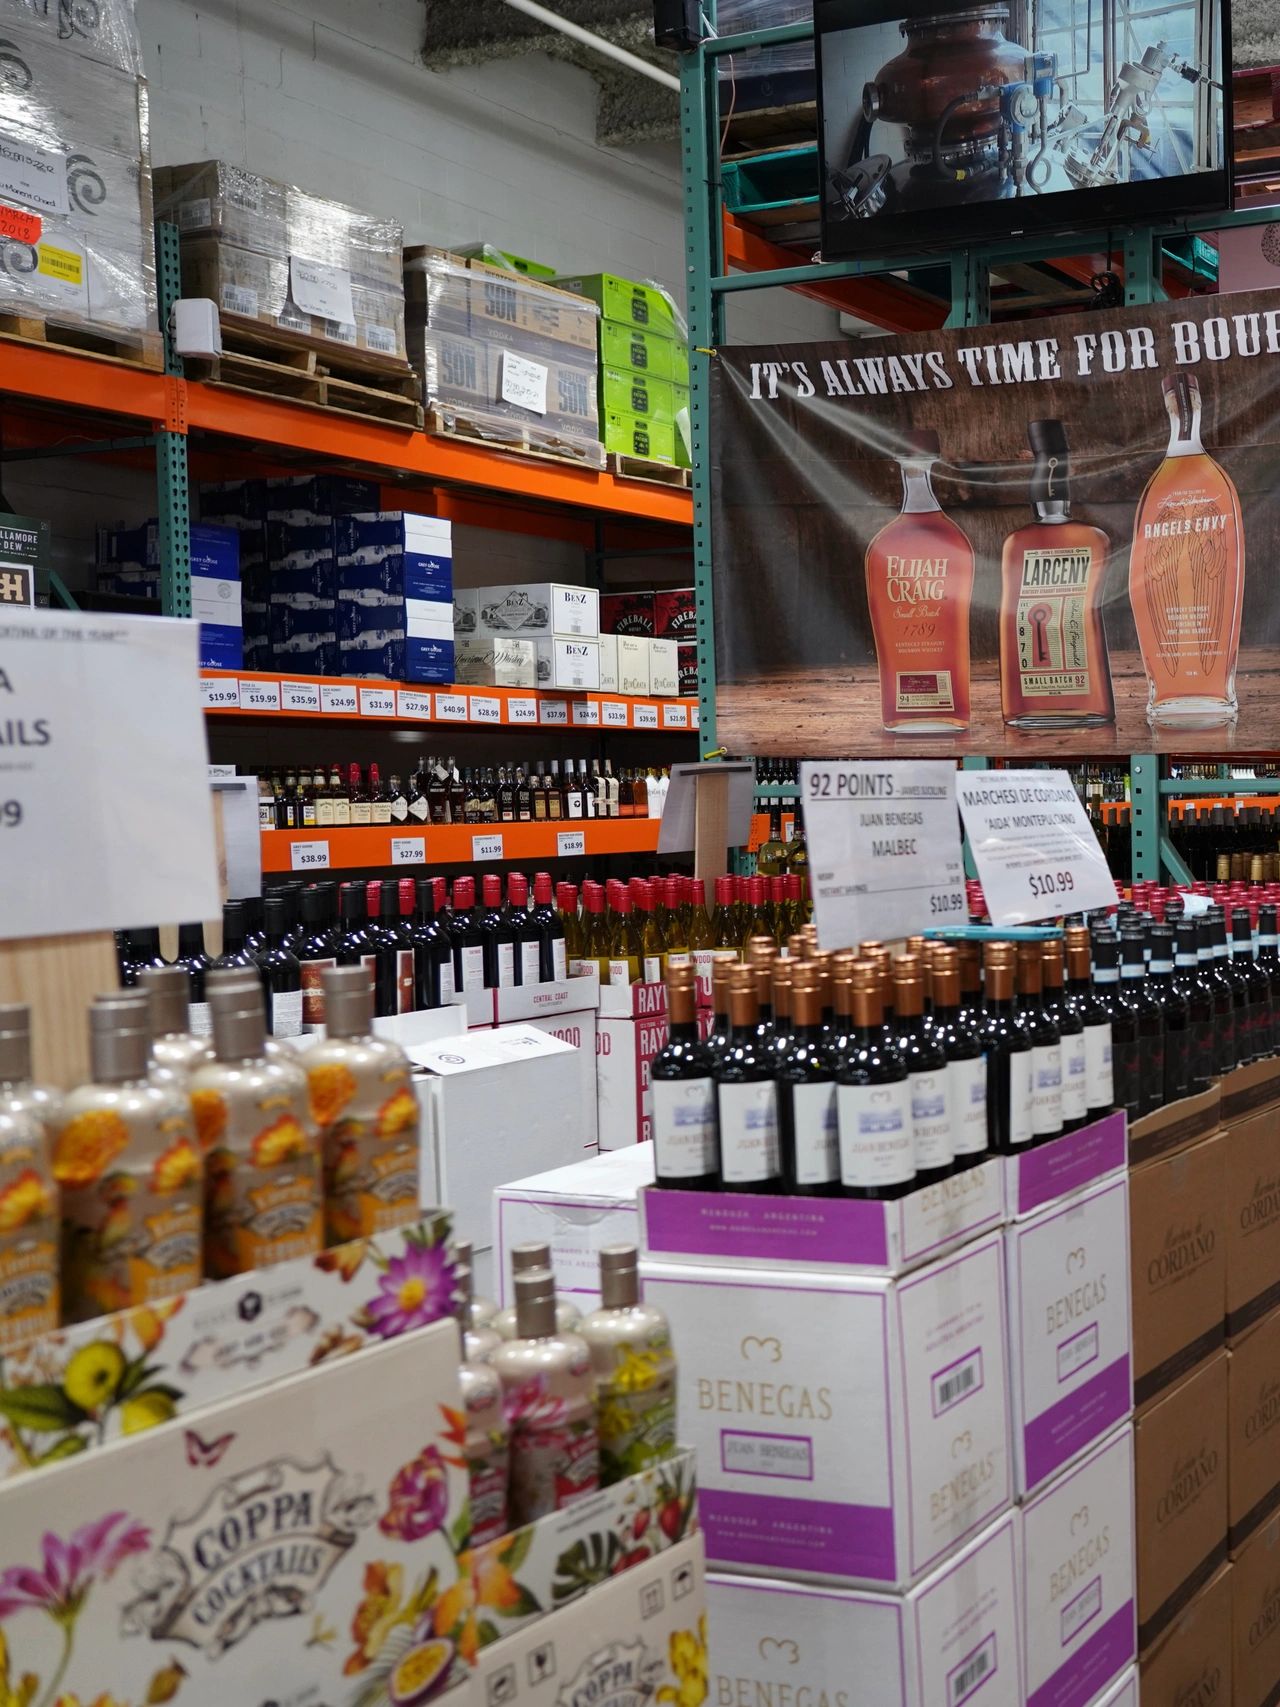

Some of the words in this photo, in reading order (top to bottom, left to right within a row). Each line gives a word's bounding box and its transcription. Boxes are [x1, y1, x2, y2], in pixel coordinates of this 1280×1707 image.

[1, 220, 31, 240] 2018
[749, 360, 816, 400] IT'S
[824, 351, 953, 398] ALWAYS
[958, 339, 1061, 386] TIME
[1075, 326, 1160, 377] FOR
[1195, 514, 1228, 533] ENVY
[3, 540, 23, 551] DEW
[202, 555, 218, 565] GOOSE
[417, 561, 428, 569] GREY
[428, 560, 440, 569] GOOSE
[886, 555, 948, 581] ELIJAH
[1023, 556, 1090, 587] LARCENY
[886, 575, 945, 604] CRAIG
[564, 591, 587, 605] BENZ
[892, 605, 914, 619] Small
[914, 604, 943, 618] Batch
[616, 614, 652, 632] FIREBALL
[903, 622, 936, 638] 1789
[430, 644, 442, 653] GOOSE
[566, 644, 588, 657] BENZ
[1023, 676, 1048, 685] SMALL
[1049, 675, 1073, 684] BATCH
[1074, 675, 1085, 684] 92
[208, 692, 238, 703] $19.99
[249, 694, 278, 704] $19.99
[290, 695, 318, 705] $35.99
[330, 698, 356, 708] $24.99
[369, 701, 394, 710] $31.99
[405, 702, 429, 712] $27.99
[443, 705, 466, 715] $40.99
[477, 708, 499, 718] $28.99
[515, 709, 536, 718] $24.99
[546, 710, 566, 719] $37.99
[579, 710, 598, 719] $24.99
[607, 711, 626, 720] $33.99
[639, 714, 657, 723] $39.99
[669, 714, 686, 723] $21.99
[810, 773, 831, 797] 92
[837, 773, 894, 797] POINTS
[962, 788, 1018, 808] MARCHESI
[1019, 788, 1035, 803] DE
[1035, 789, 1076, 803] CORDANO
[859, 812, 884, 828] JUAN
[884, 811, 924, 826] BENEGAS
[480, 845, 502, 854] $11.99
[564, 841, 583, 850] $18.99
[871, 838, 918, 857] MALBEC
[300, 853, 327, 863] $38.99
[400, 850, 424, 859] $27.99
[1029, 871, 1075, 899] $10.99
[929, 893, 963, 915] $10.99
[533, 993, 553, 1005] CENTRAL
[554, 991, 569, 1001] COAST
[1147, 1229, 1217, 1287] CORDANO
[1046, 1273, 1107, 1336] BENEGAS
[696, 1377, 833, 1422] BENEGAS
[930, 1452, 996, 1523] BENEGAS
[1155, 1450, 1219, 1526] CORDANO
[193, 1490, 314, 1573] COPPA
[1049, 1525, 1112, 1602] BENEGAS
[191, 1545, 323, 1627] COCKTAILS
